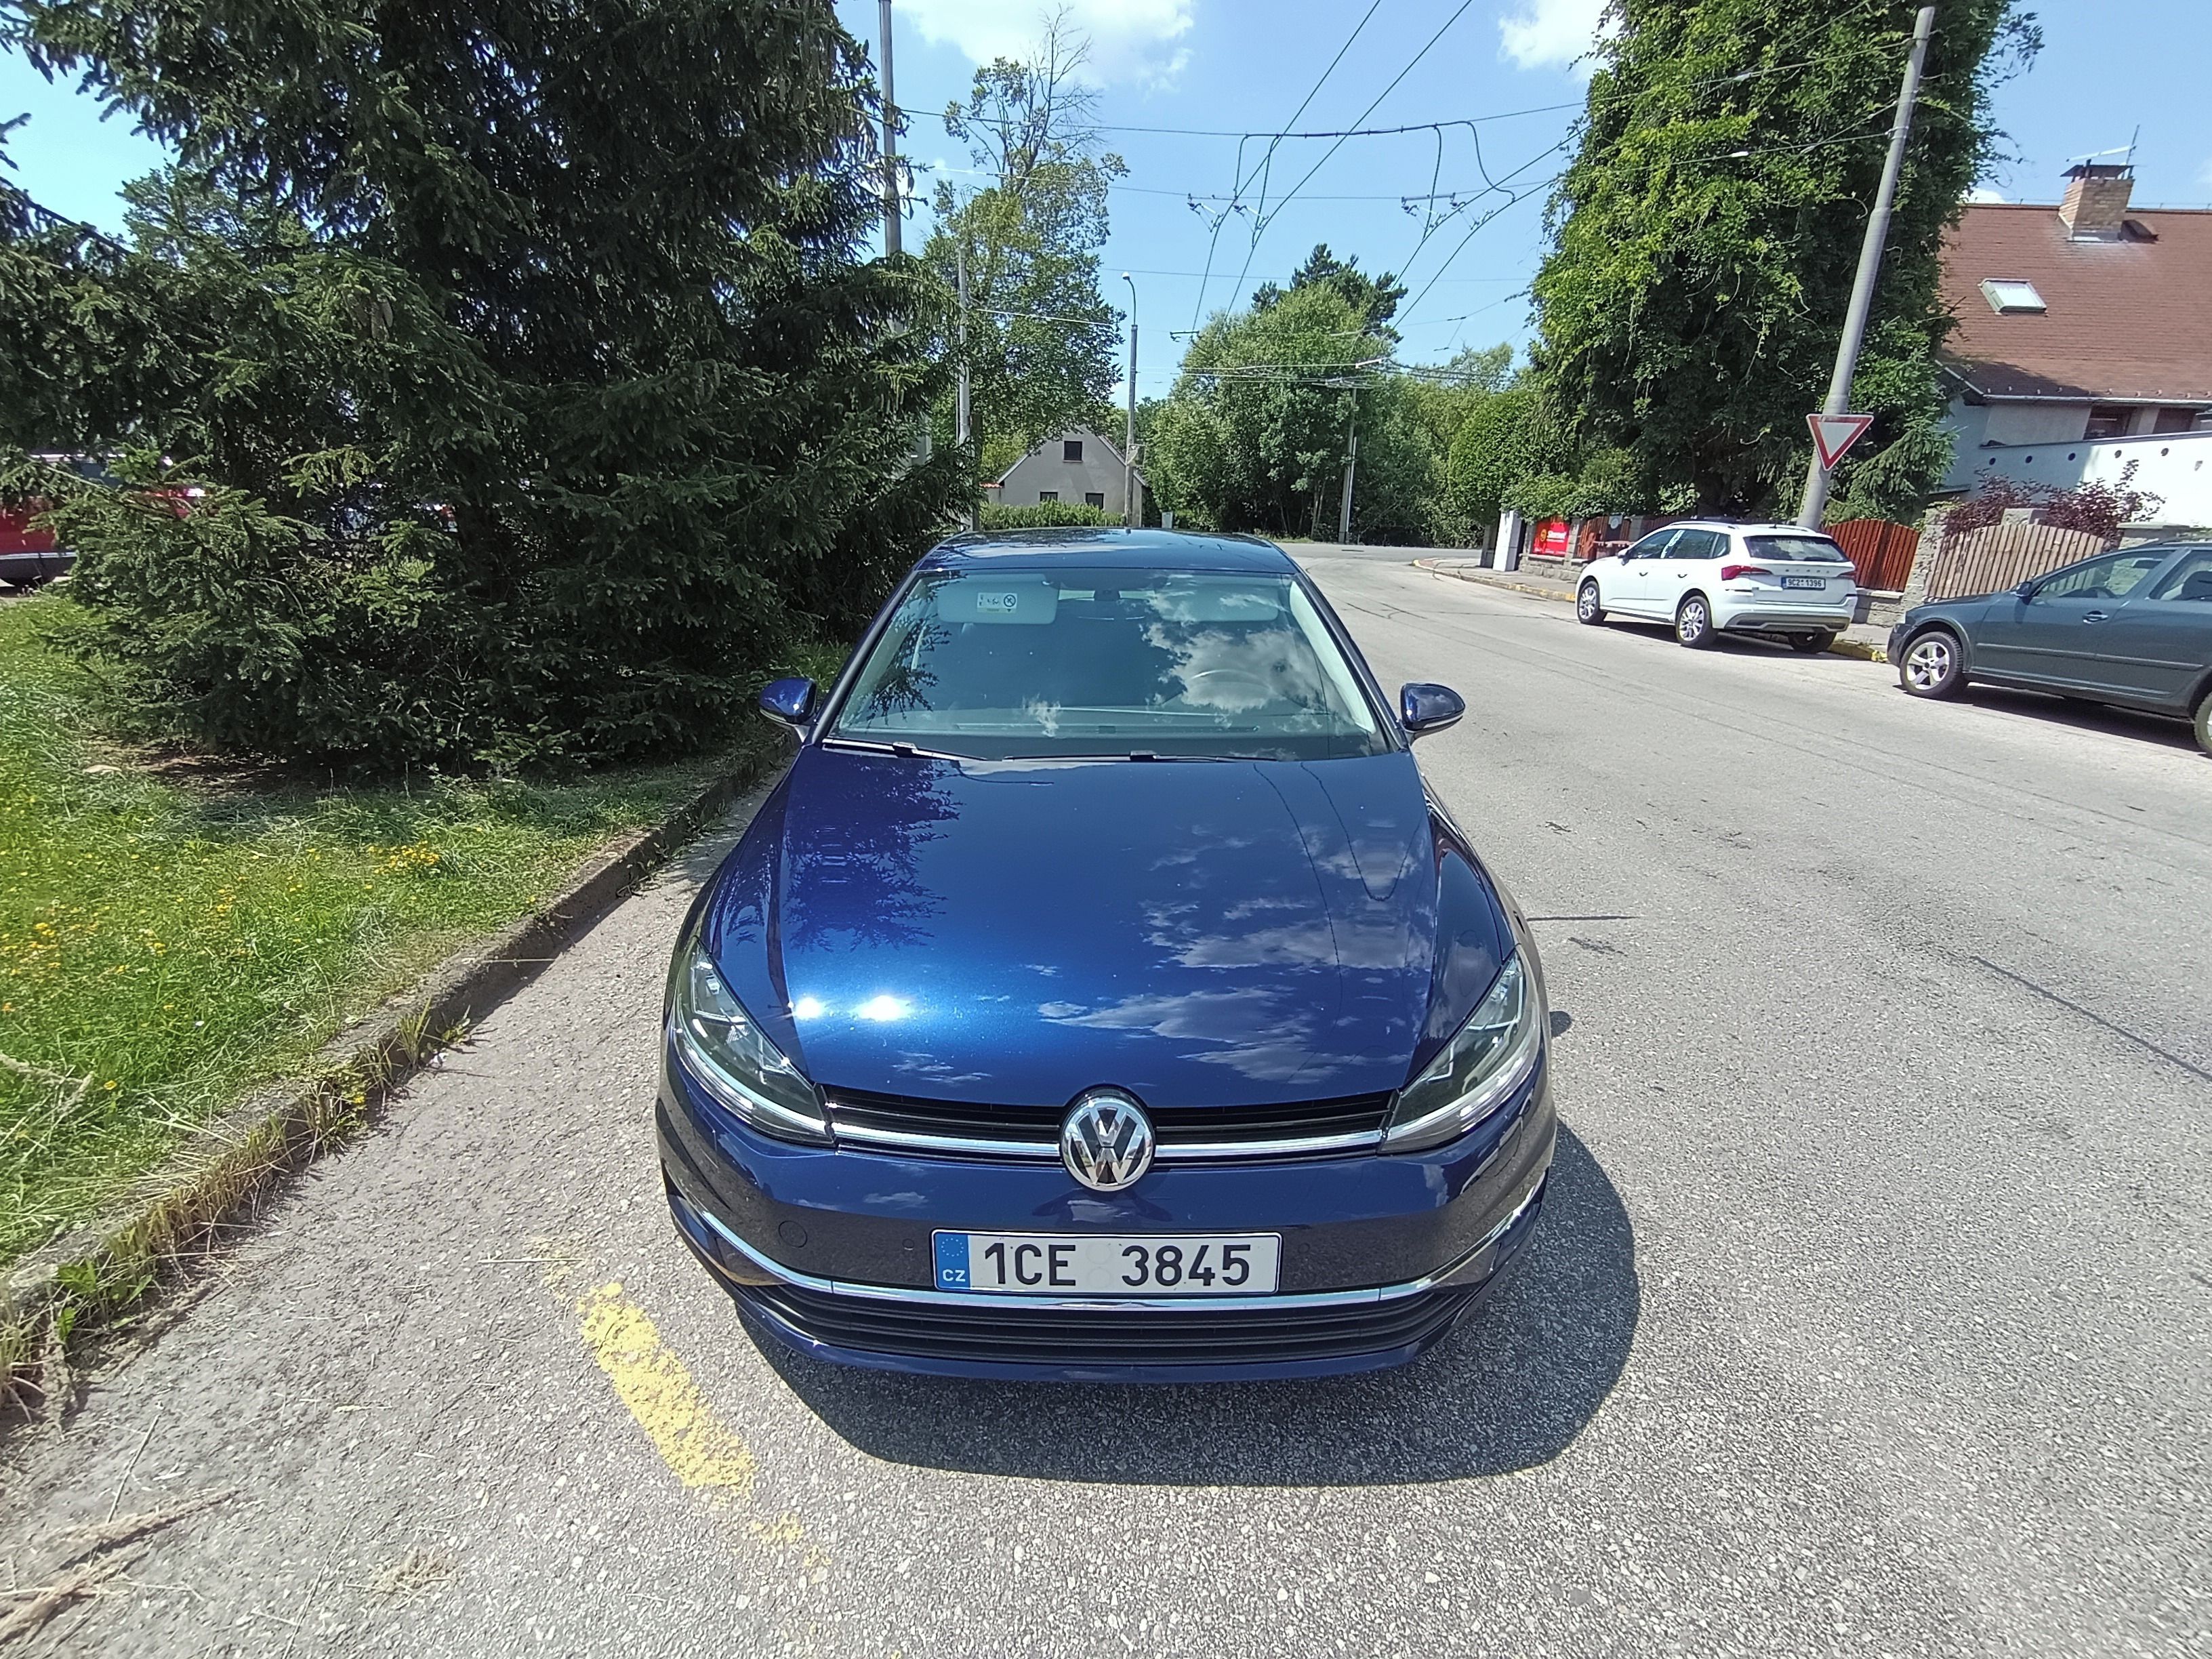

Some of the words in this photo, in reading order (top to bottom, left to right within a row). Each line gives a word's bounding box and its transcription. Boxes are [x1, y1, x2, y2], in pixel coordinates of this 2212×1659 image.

[1065, 1102, 1151, 1187] VW
[942, 1269, 966, 1282] CZ
[985, 1242, 1076, 1286] 1CE
[1122, 1244, 1251, 1286] 3845
